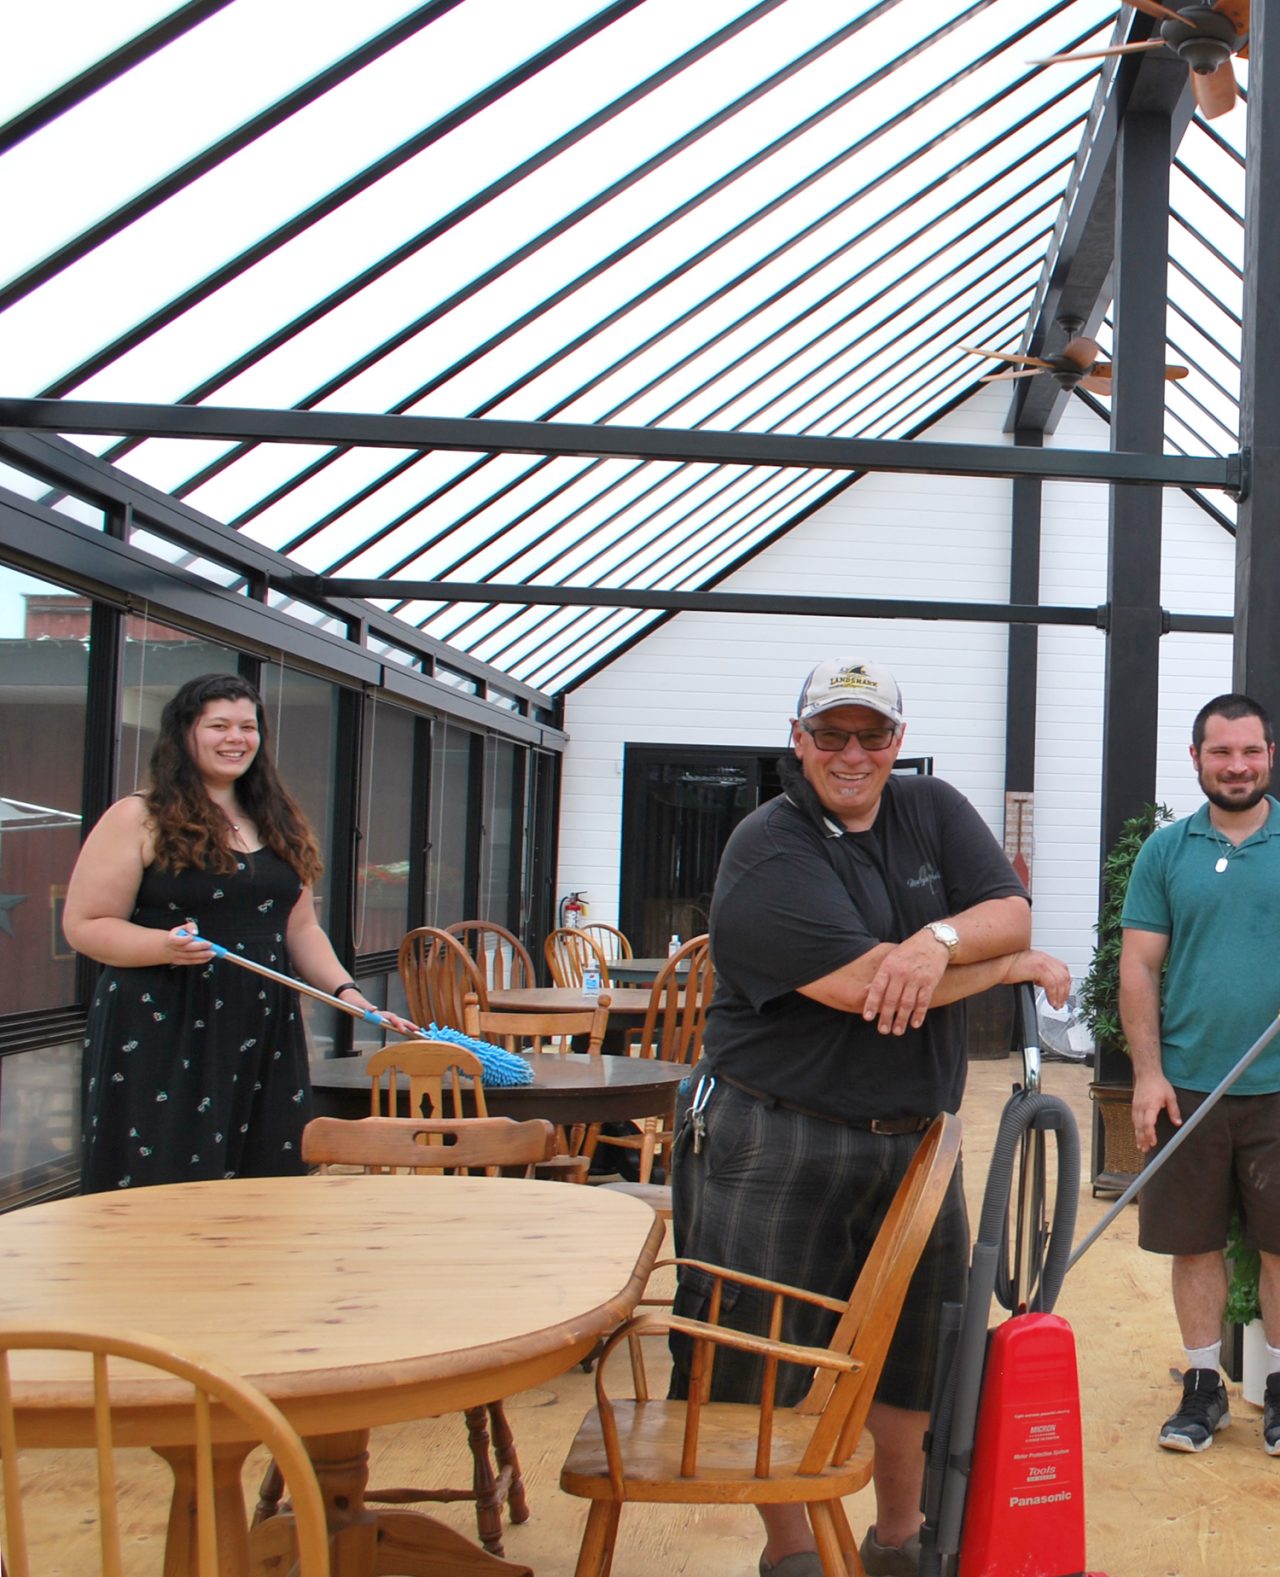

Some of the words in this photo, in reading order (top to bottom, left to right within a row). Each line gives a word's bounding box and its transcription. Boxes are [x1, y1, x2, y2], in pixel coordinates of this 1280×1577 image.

[1030, 1424, 1056, 1434] MICRON
[1029, 1466, 1056, 1476] Tools
[1009, 1491, 1072, 1507] Panasonic
